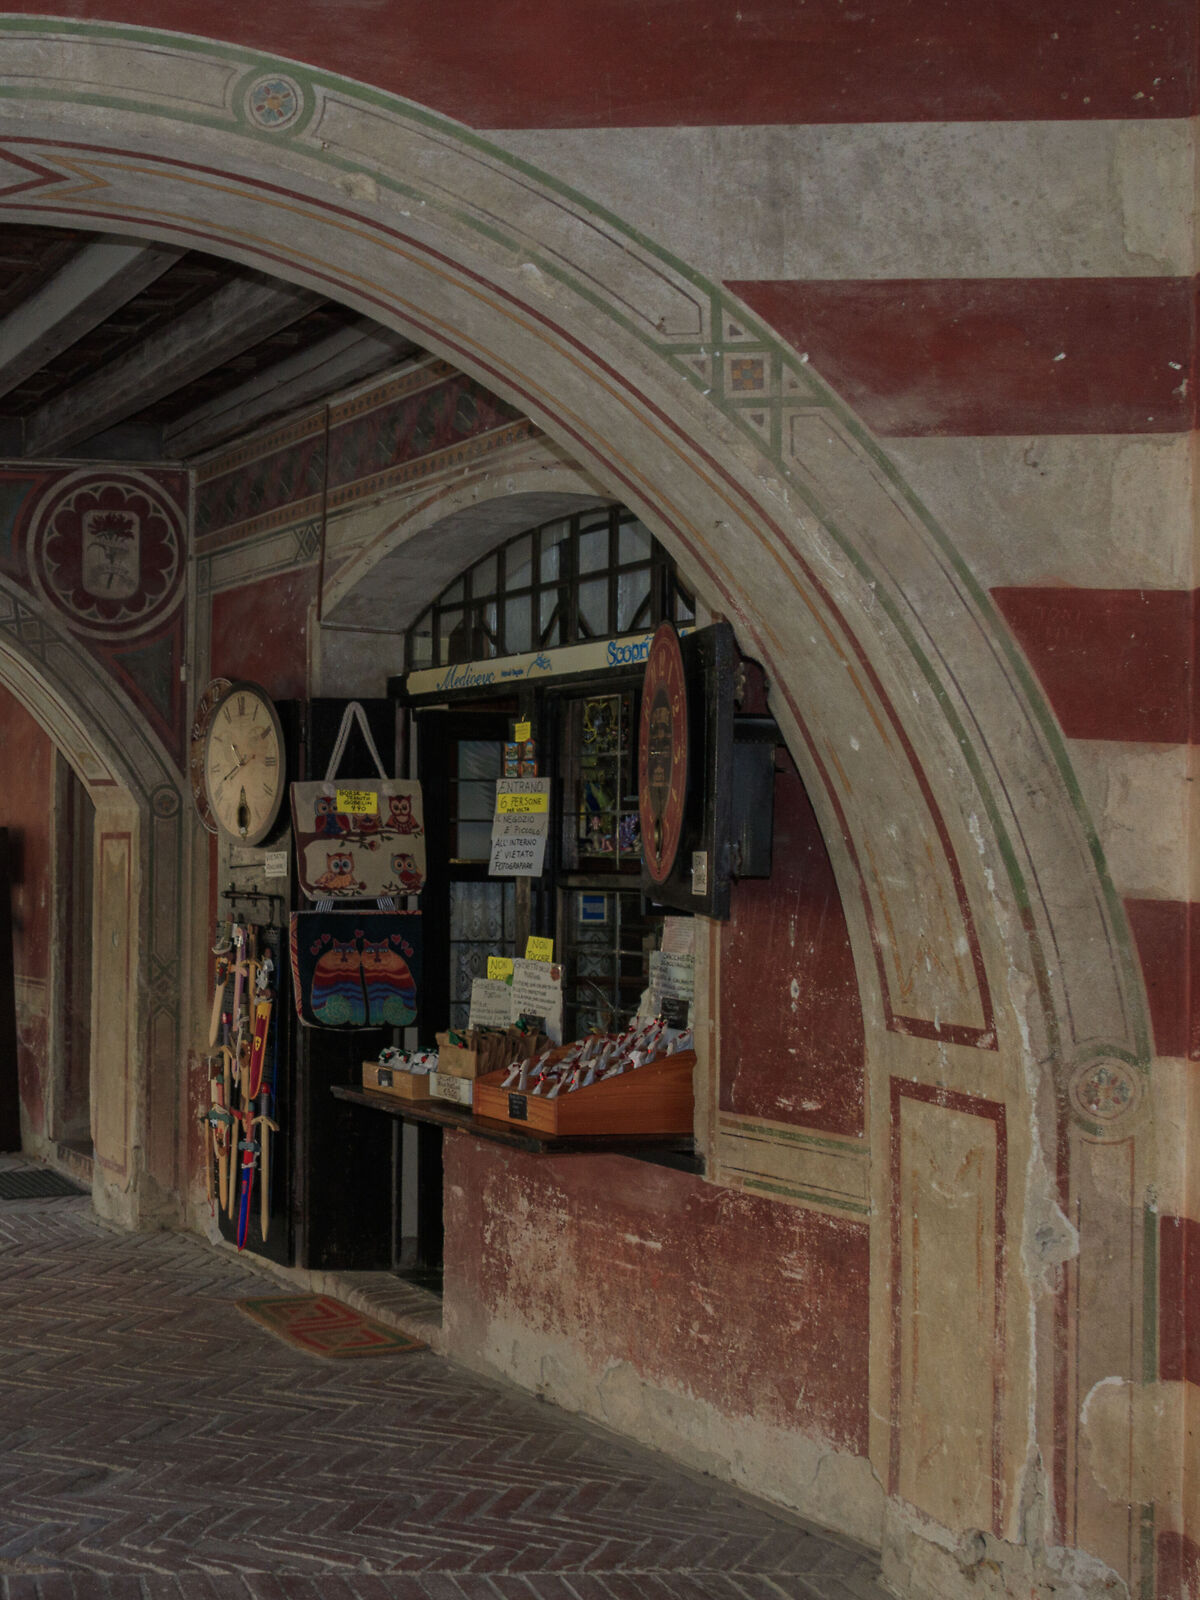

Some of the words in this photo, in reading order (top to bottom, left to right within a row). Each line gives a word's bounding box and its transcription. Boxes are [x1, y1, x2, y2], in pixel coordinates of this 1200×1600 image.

[498, 781, 543, 794] ENTRANO
[500, 796, 506, 808] 6
[510, 797, 542, 807] PERSONE
[503, 815, 535, 824] NEGOZIO
[505, 850, 534, 859] VIETATO
[491, 959, 508, 969] NON
